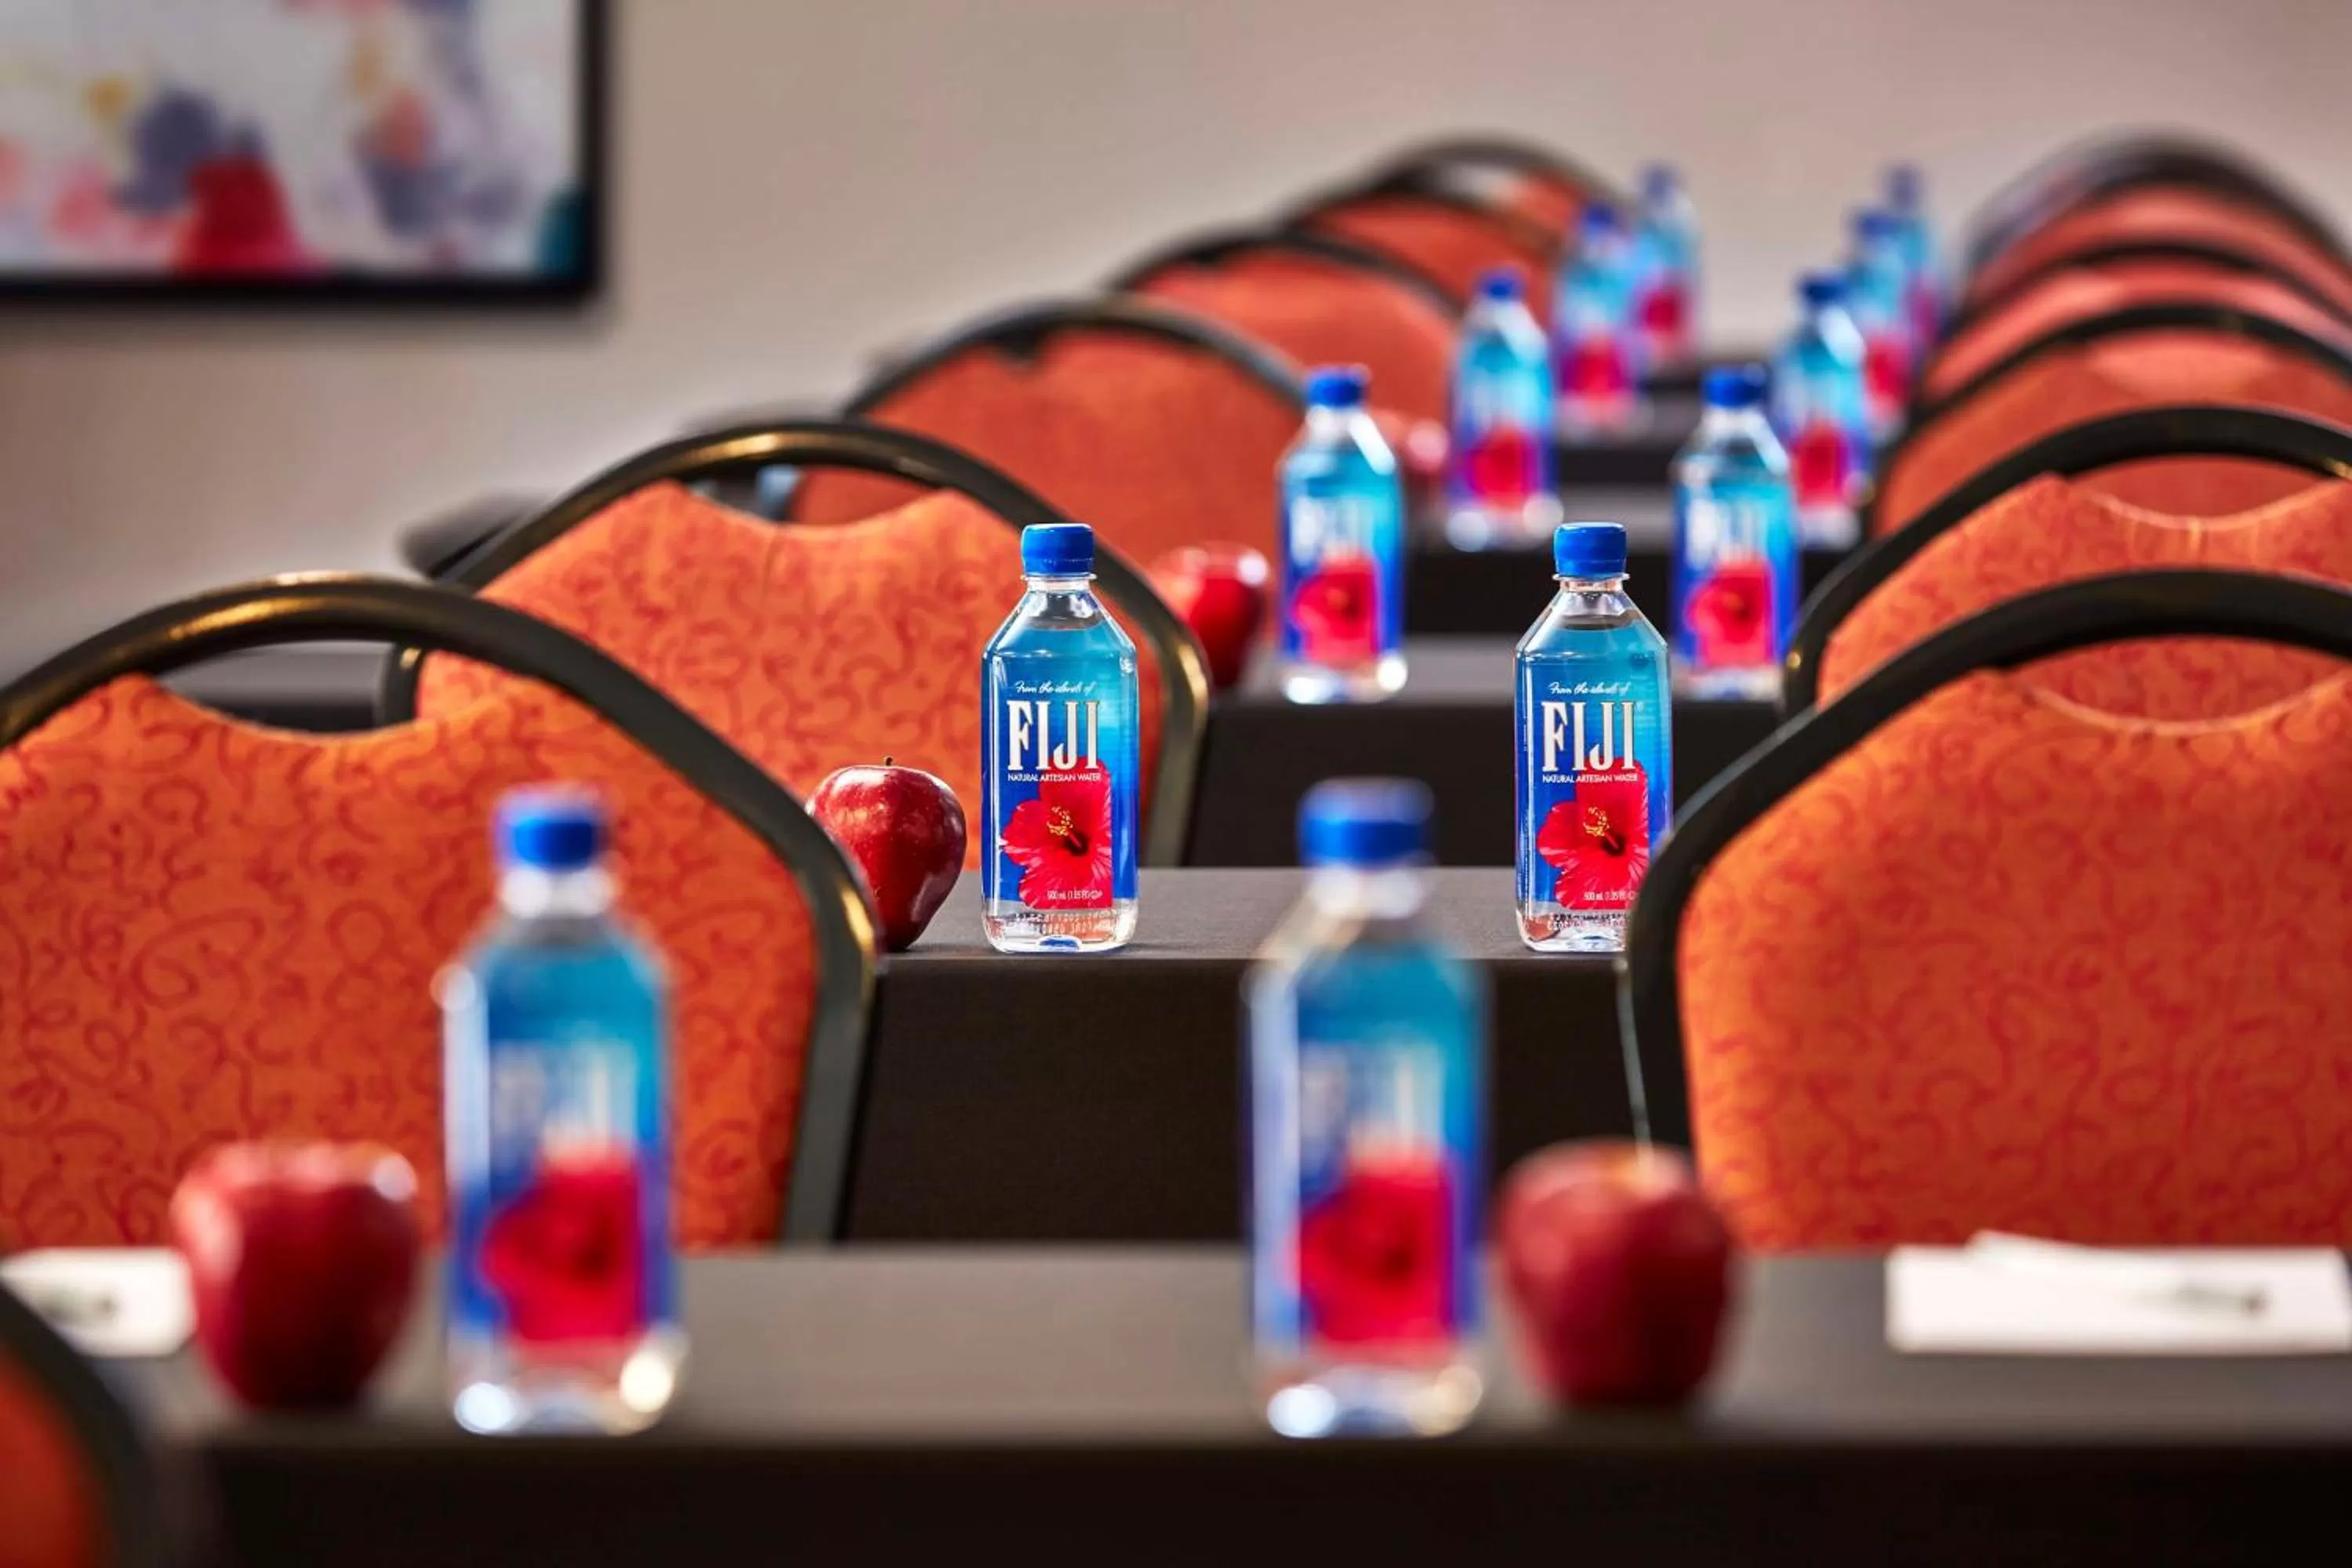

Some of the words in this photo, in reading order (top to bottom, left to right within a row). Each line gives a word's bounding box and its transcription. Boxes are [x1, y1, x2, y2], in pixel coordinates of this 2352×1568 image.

[1007, 699, 1099, 771] FIJI
[1541, 701, 1635, 772] FIJI
[1007, 773, 1038, 782] NATURAL
[1040, 773, 1075, 782] ARTESIAN
[1076, 772, 1102, 782] WATER
[1542, 774, 1575, 783] NATURAL
[1575, 774, 1613, 783] ARTESIAN
